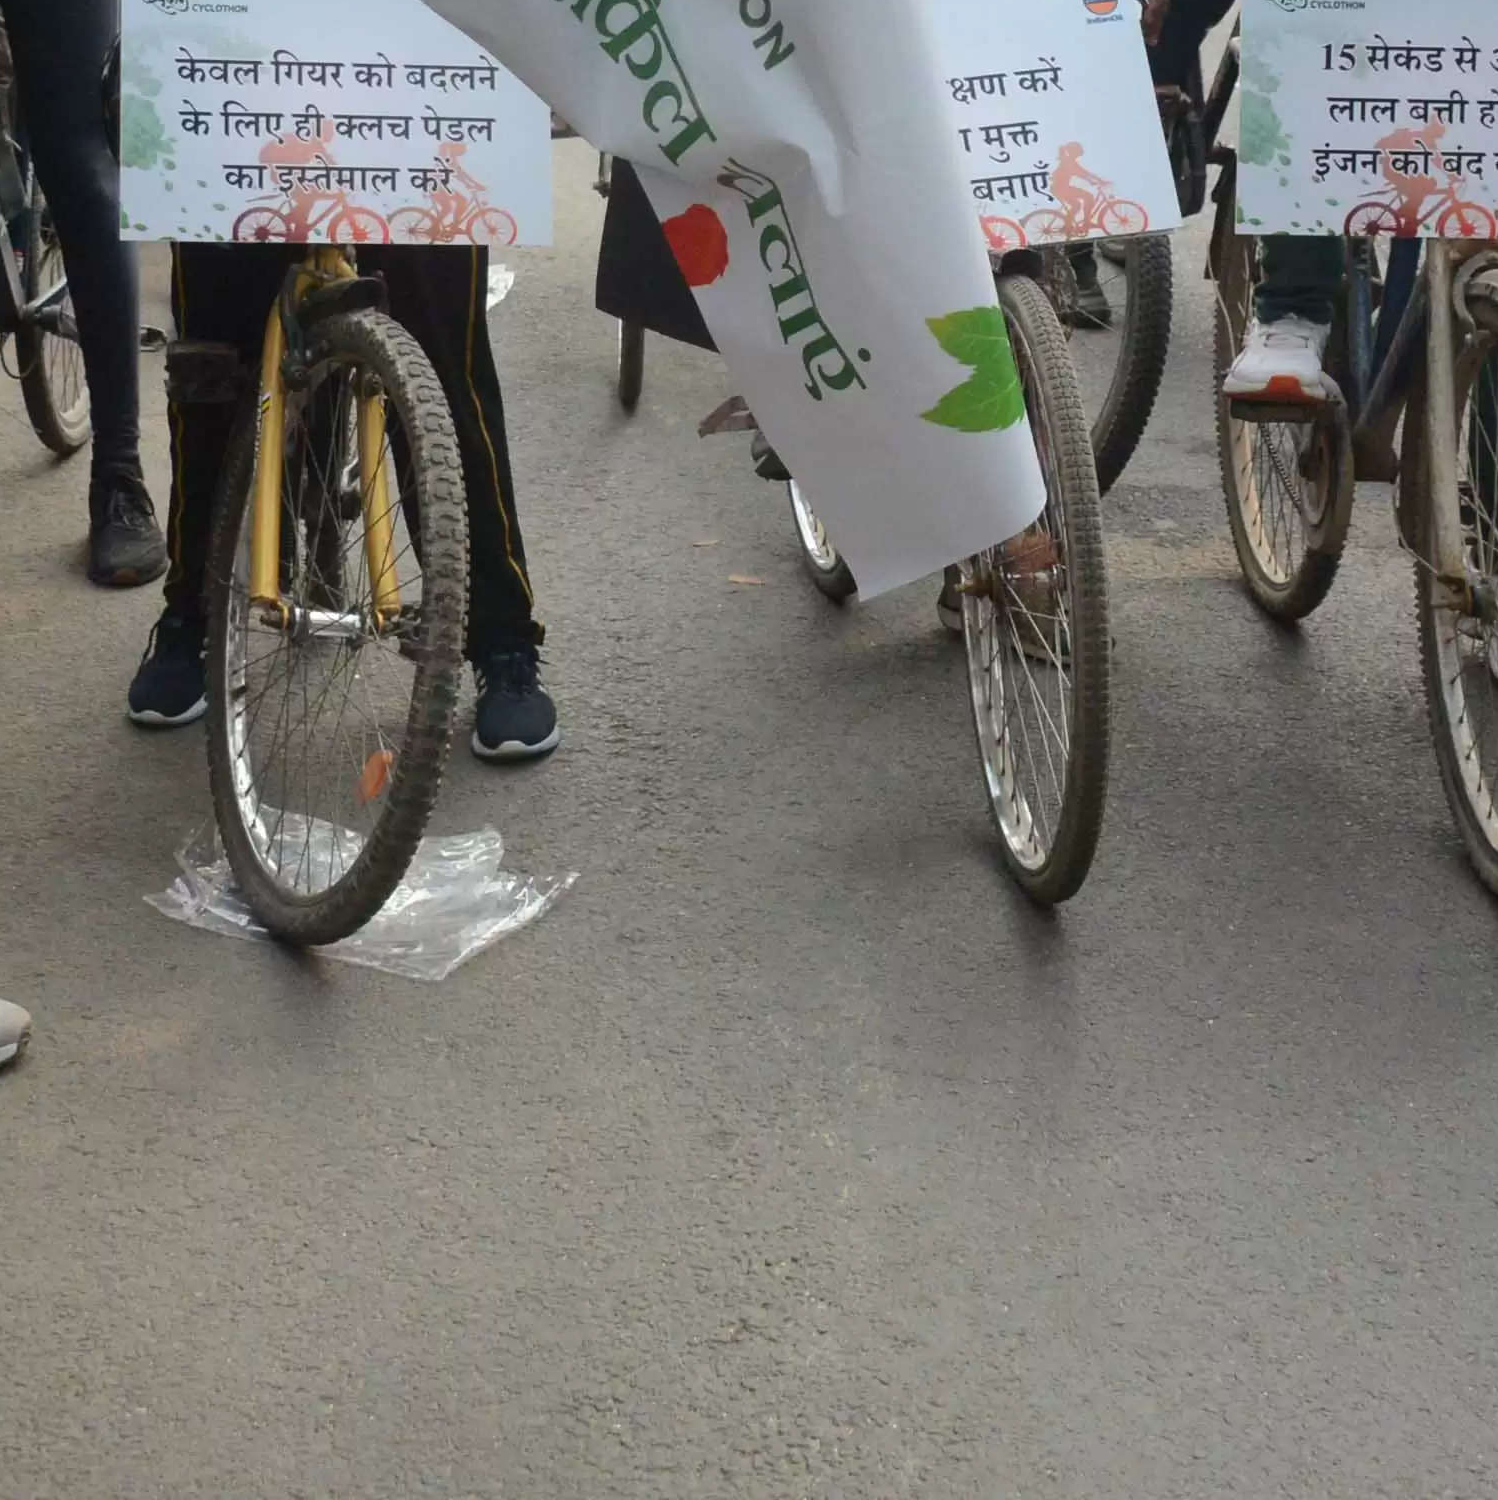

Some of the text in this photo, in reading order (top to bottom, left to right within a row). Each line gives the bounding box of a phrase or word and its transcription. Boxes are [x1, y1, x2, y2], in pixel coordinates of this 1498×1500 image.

[191, 3, 249, 13] CYCLOTHON
[1309, 0, 1366, 11] CYCLOTHON
[175, 47, 499, 93] केवल गियर को बदलने
[1322, 43, 1357, 72] 15
[1365, 34, 1445, 74] सेकंड
[1453, 36, 1480, 74] से
[946, 56, 1064, 104] क्षण करें
[178, 99, 496, 145] के लिए ही क्लच पेडल
[1326, 97, 1399, 125] लाल
[1407, 91, 1469, 126] बत्ती
[979, 120, 1039, 164] मुक्त
[1312, 143, 1382, 179] इंजन
[1388, 140, 1434, 176] को
[1439, 145, 1487, 180] बंद
[223, 154, 455, 197] का इस्तेमाल करें
[970, 160, 1054, 202] बनाएँ
